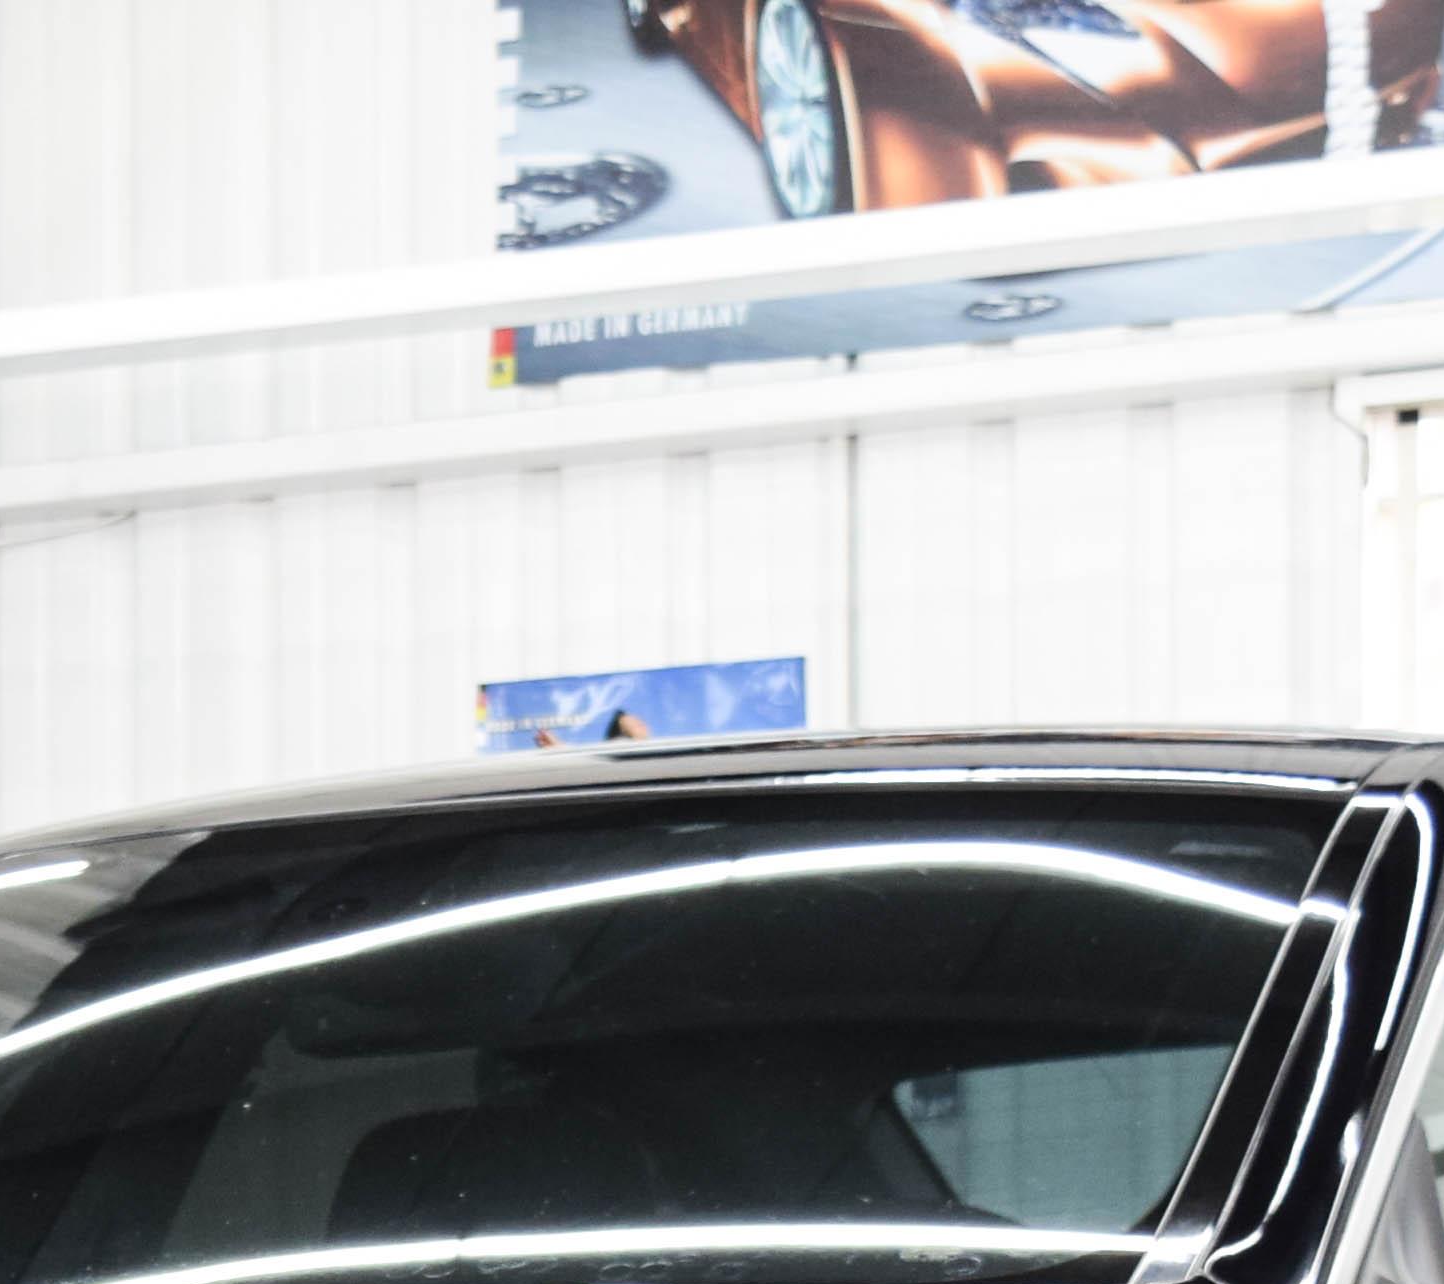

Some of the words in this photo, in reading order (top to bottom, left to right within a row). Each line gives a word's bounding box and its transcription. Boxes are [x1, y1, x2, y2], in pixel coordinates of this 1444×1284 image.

[533, 316, 598, 348] MADE
[603, 312, 631, 340] IN
[636, 303, 750, 336] GERMANY
